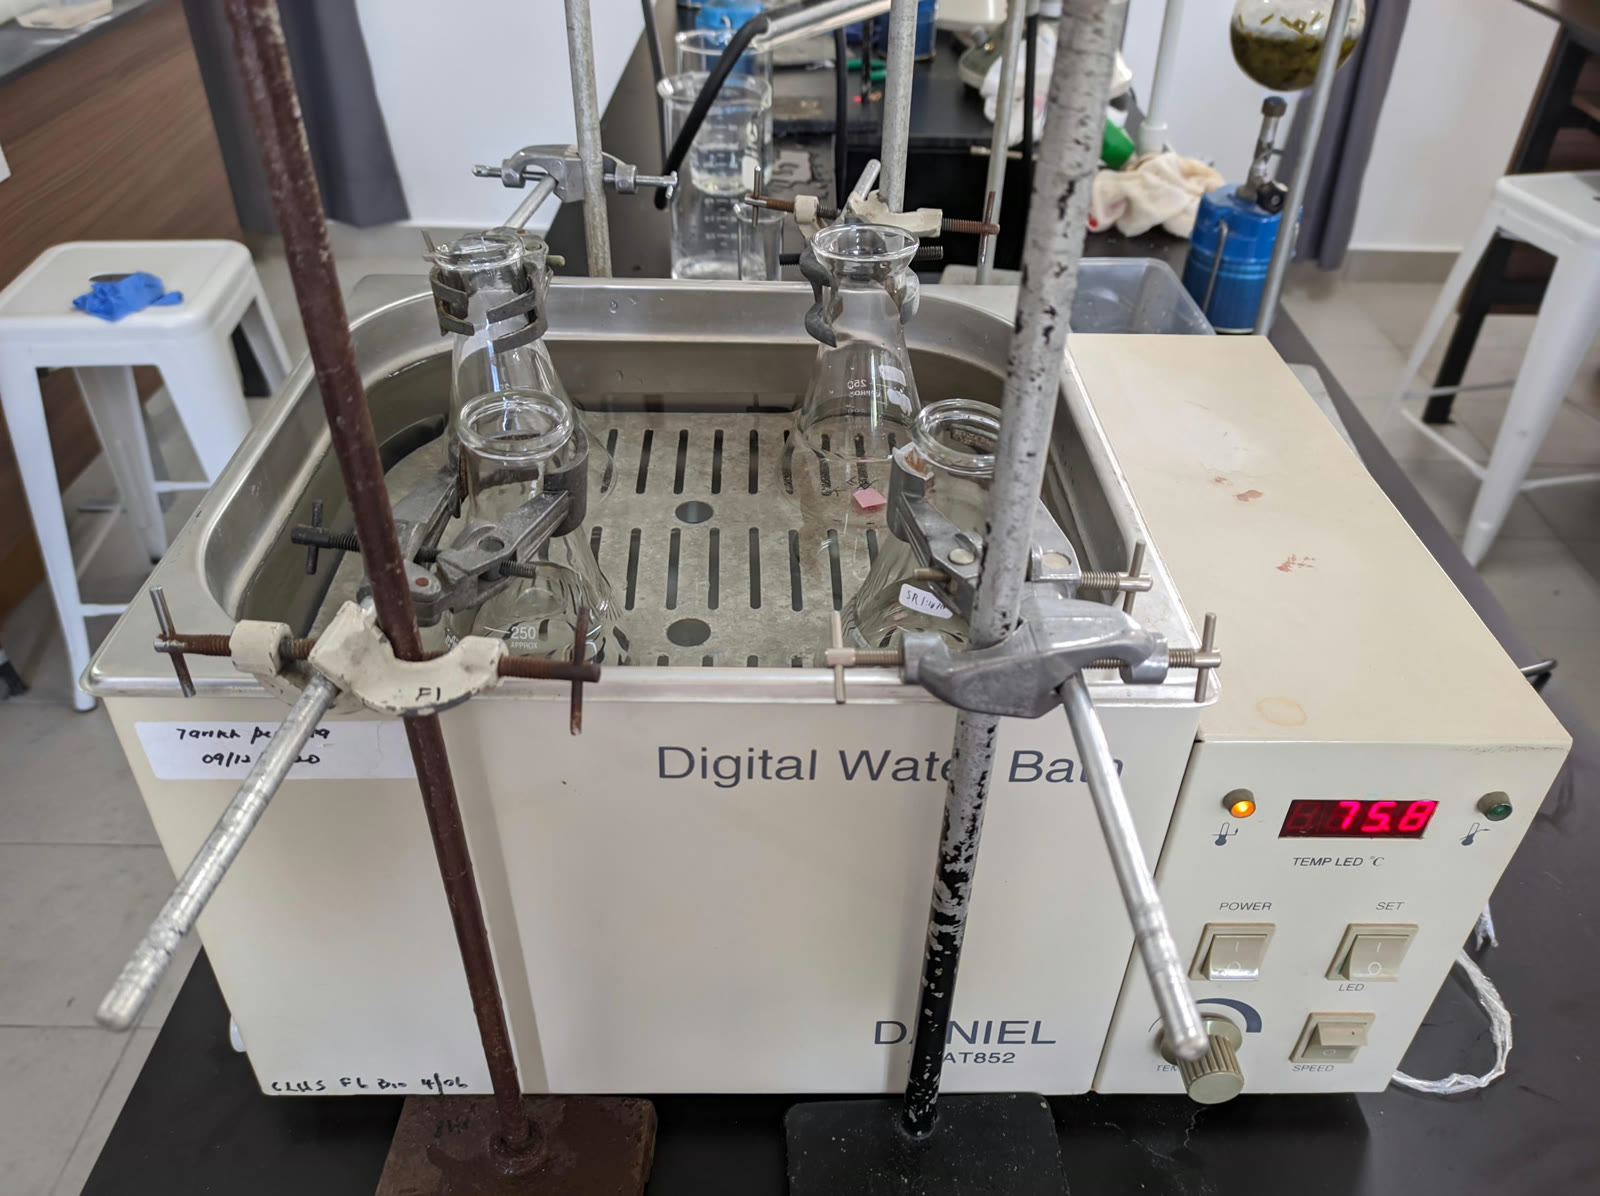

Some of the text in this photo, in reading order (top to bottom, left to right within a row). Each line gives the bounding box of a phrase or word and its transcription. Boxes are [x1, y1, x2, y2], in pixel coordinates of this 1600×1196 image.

[511, 626, 536, 640] 250
[657, 745, 818, 788] Digital
[1292, 857, 1333, 866] TEMP
[1334, 857, 1364, 866] LED
[1219, 902, 1273, 911] POWER
[1375, 902, 1405, 911] SET
[1338, 983, 1365, 992] LED
[874, 1020, 1057, 1045] DNIEL
[1292, 1064, 1335, 1073] SPEED
